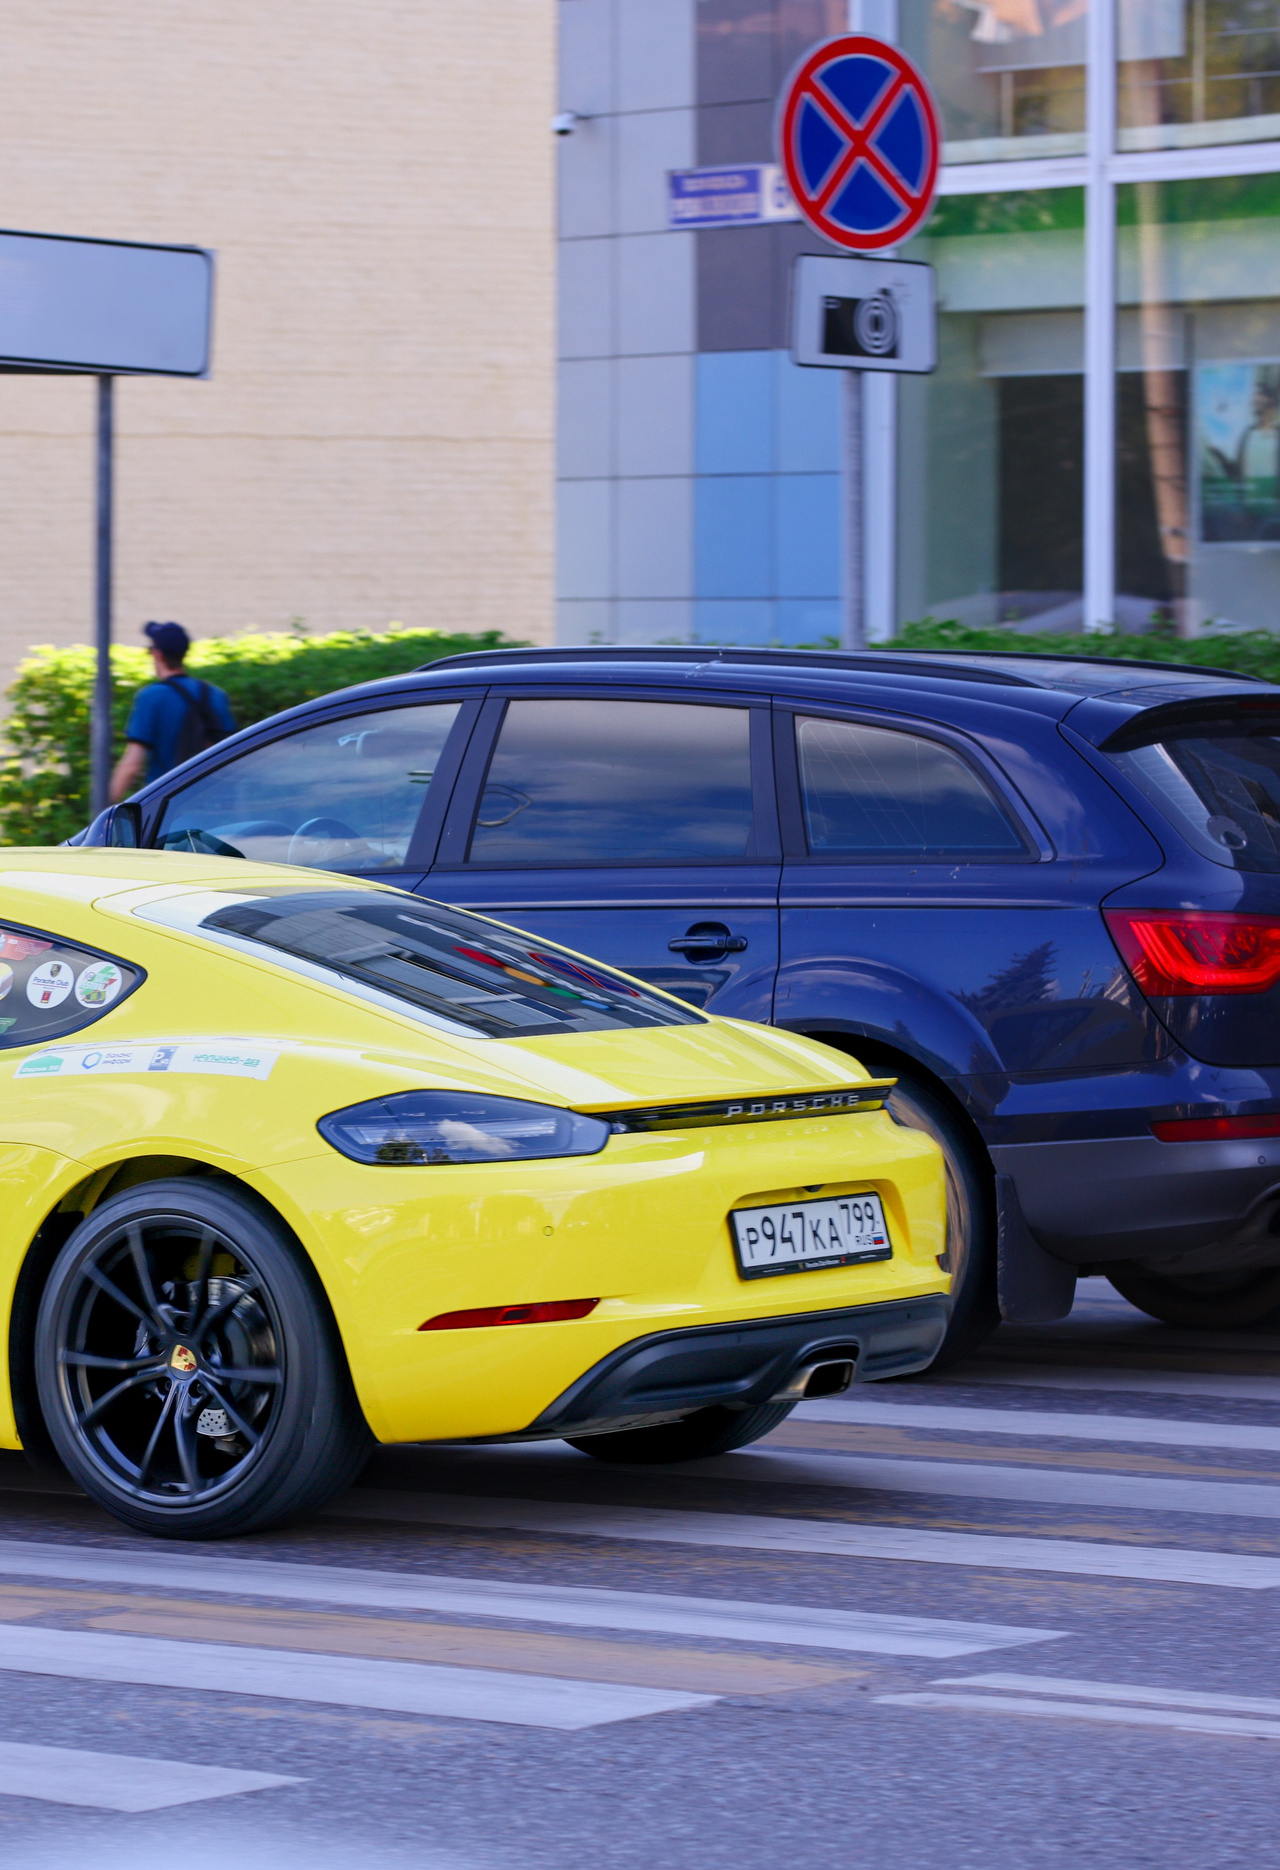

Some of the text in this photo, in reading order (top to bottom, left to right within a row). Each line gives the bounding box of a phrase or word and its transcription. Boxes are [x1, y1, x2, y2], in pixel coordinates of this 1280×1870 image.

[33, 976, 56, 985] Porsche
[723, 1095, 859, 1118] PORSCHE
[840, 1201, 875, 1235] 799
[855, 1235, 873, 1246] RUS
